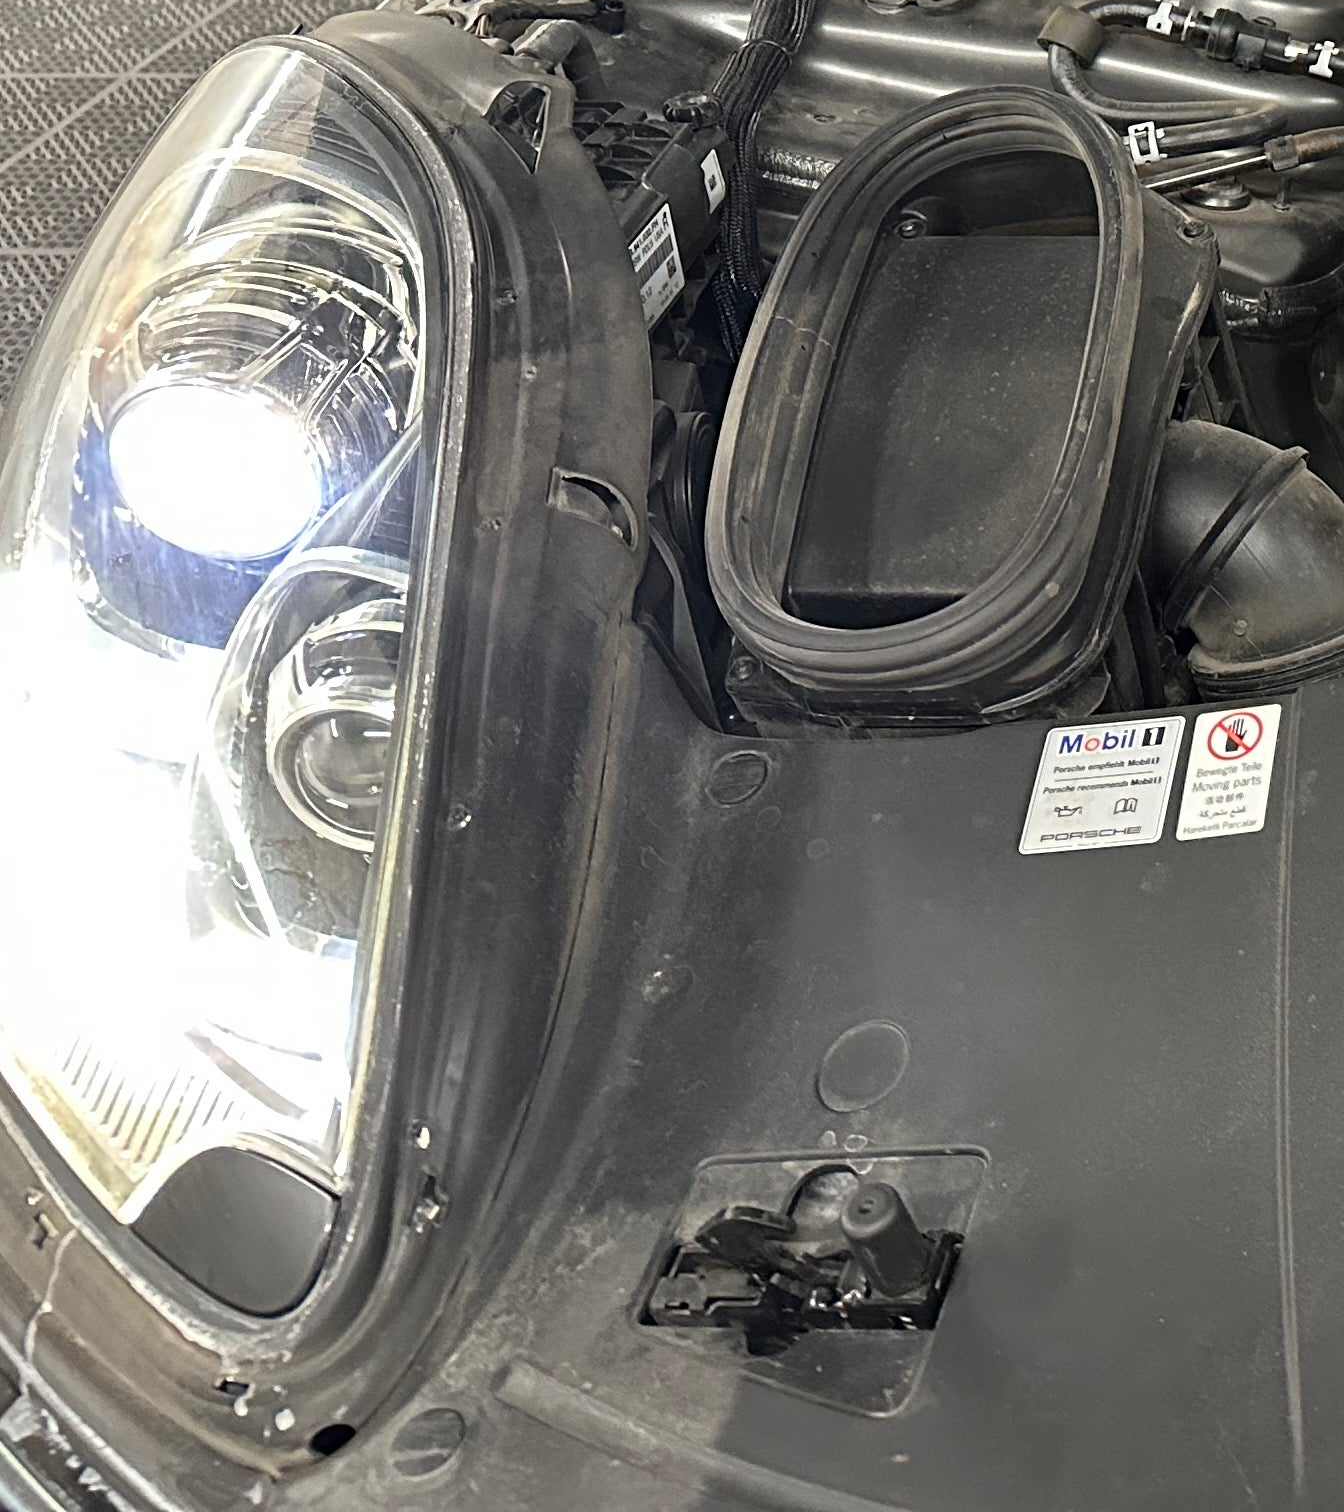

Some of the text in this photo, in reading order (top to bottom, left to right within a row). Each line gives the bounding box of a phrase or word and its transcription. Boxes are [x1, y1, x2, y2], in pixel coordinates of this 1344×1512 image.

[1058, 729, 1137, 755] Mobil
[1053, 764, 1086, 773] Porsche
[1127, 758, 1150, 767] Mobil
[1196, 761, 1262, 778] Bewegte Teile
[1043, 785, 1075, 794] Porsche
[1077, 781, 1129, 792] recommends
[1130, 777, 1153, 786] Mobil
[1192, 776, 1262, 793] Moving parts
[1040, 826, 1142, 842] PORSCHE
